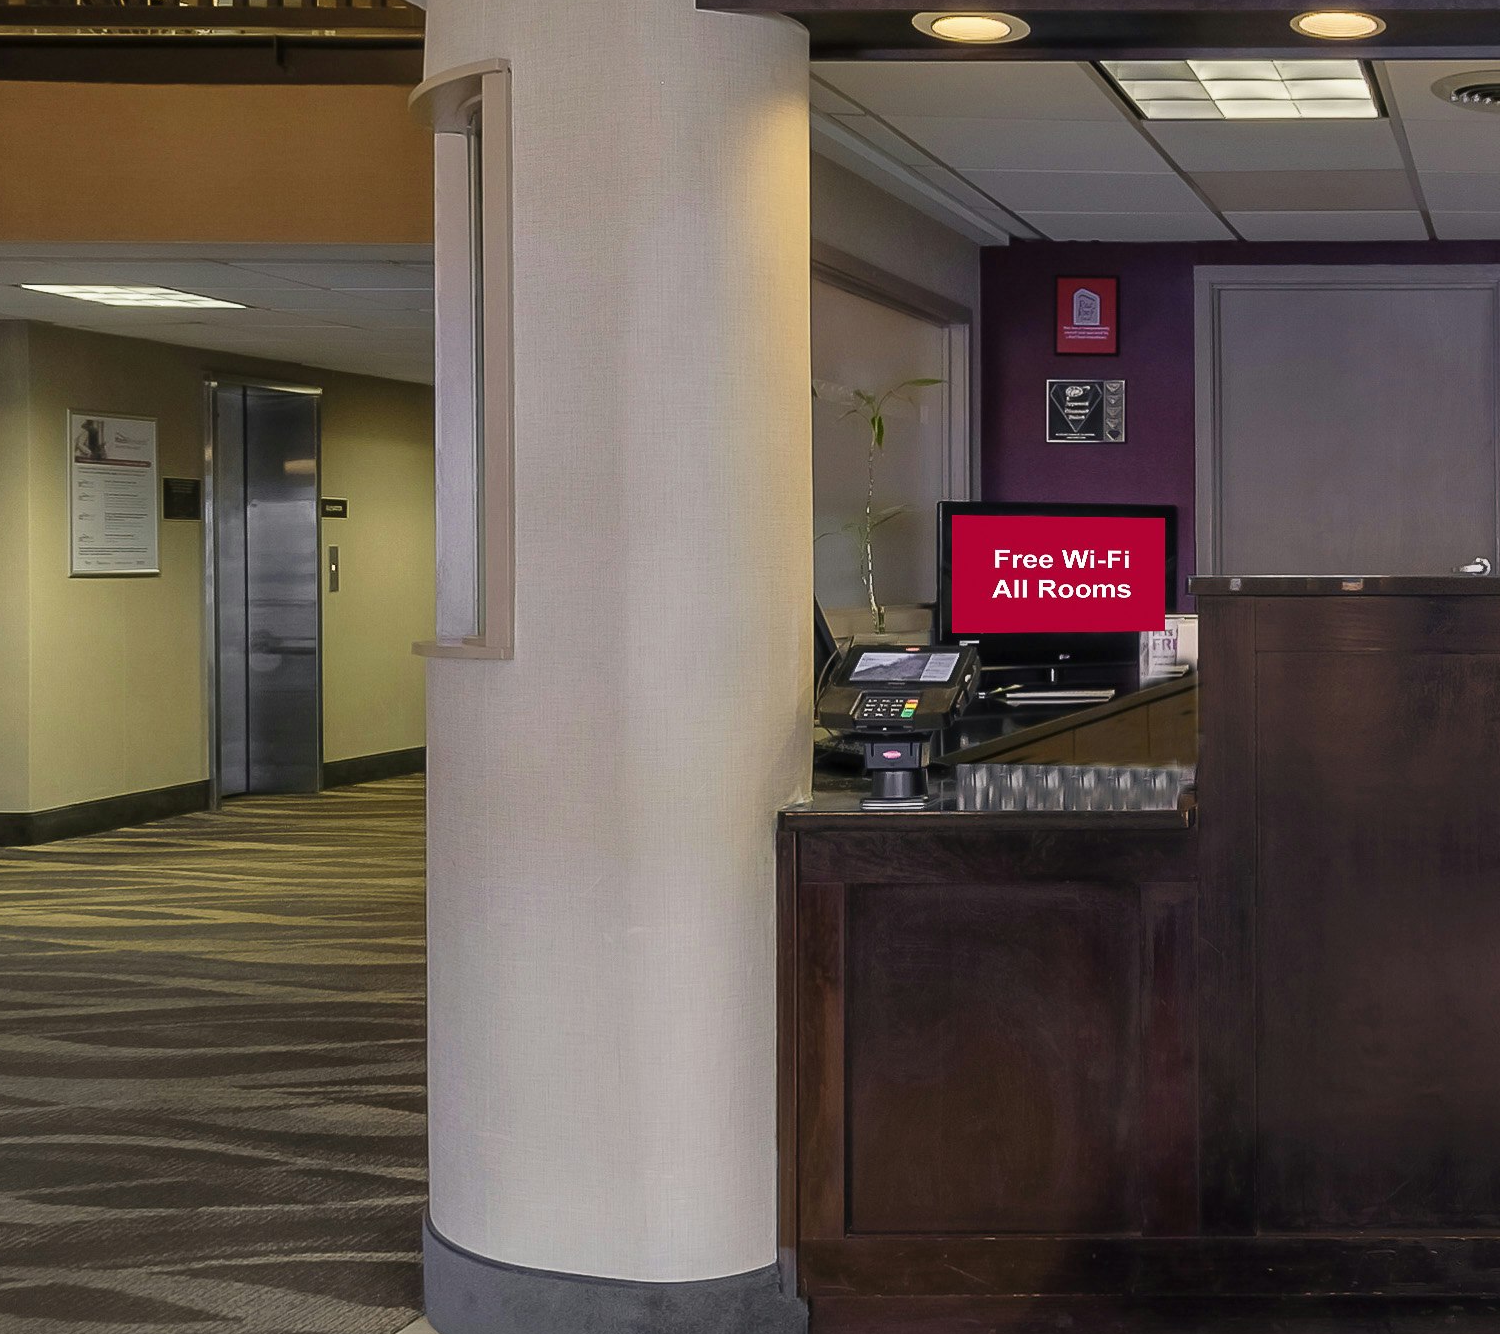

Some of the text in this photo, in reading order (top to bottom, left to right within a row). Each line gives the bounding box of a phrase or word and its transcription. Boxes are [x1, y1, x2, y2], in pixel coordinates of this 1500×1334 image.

[994, 549, 1130, 569] Free Wi-Fi
[991, 579, 1132, 599] All Rooms
